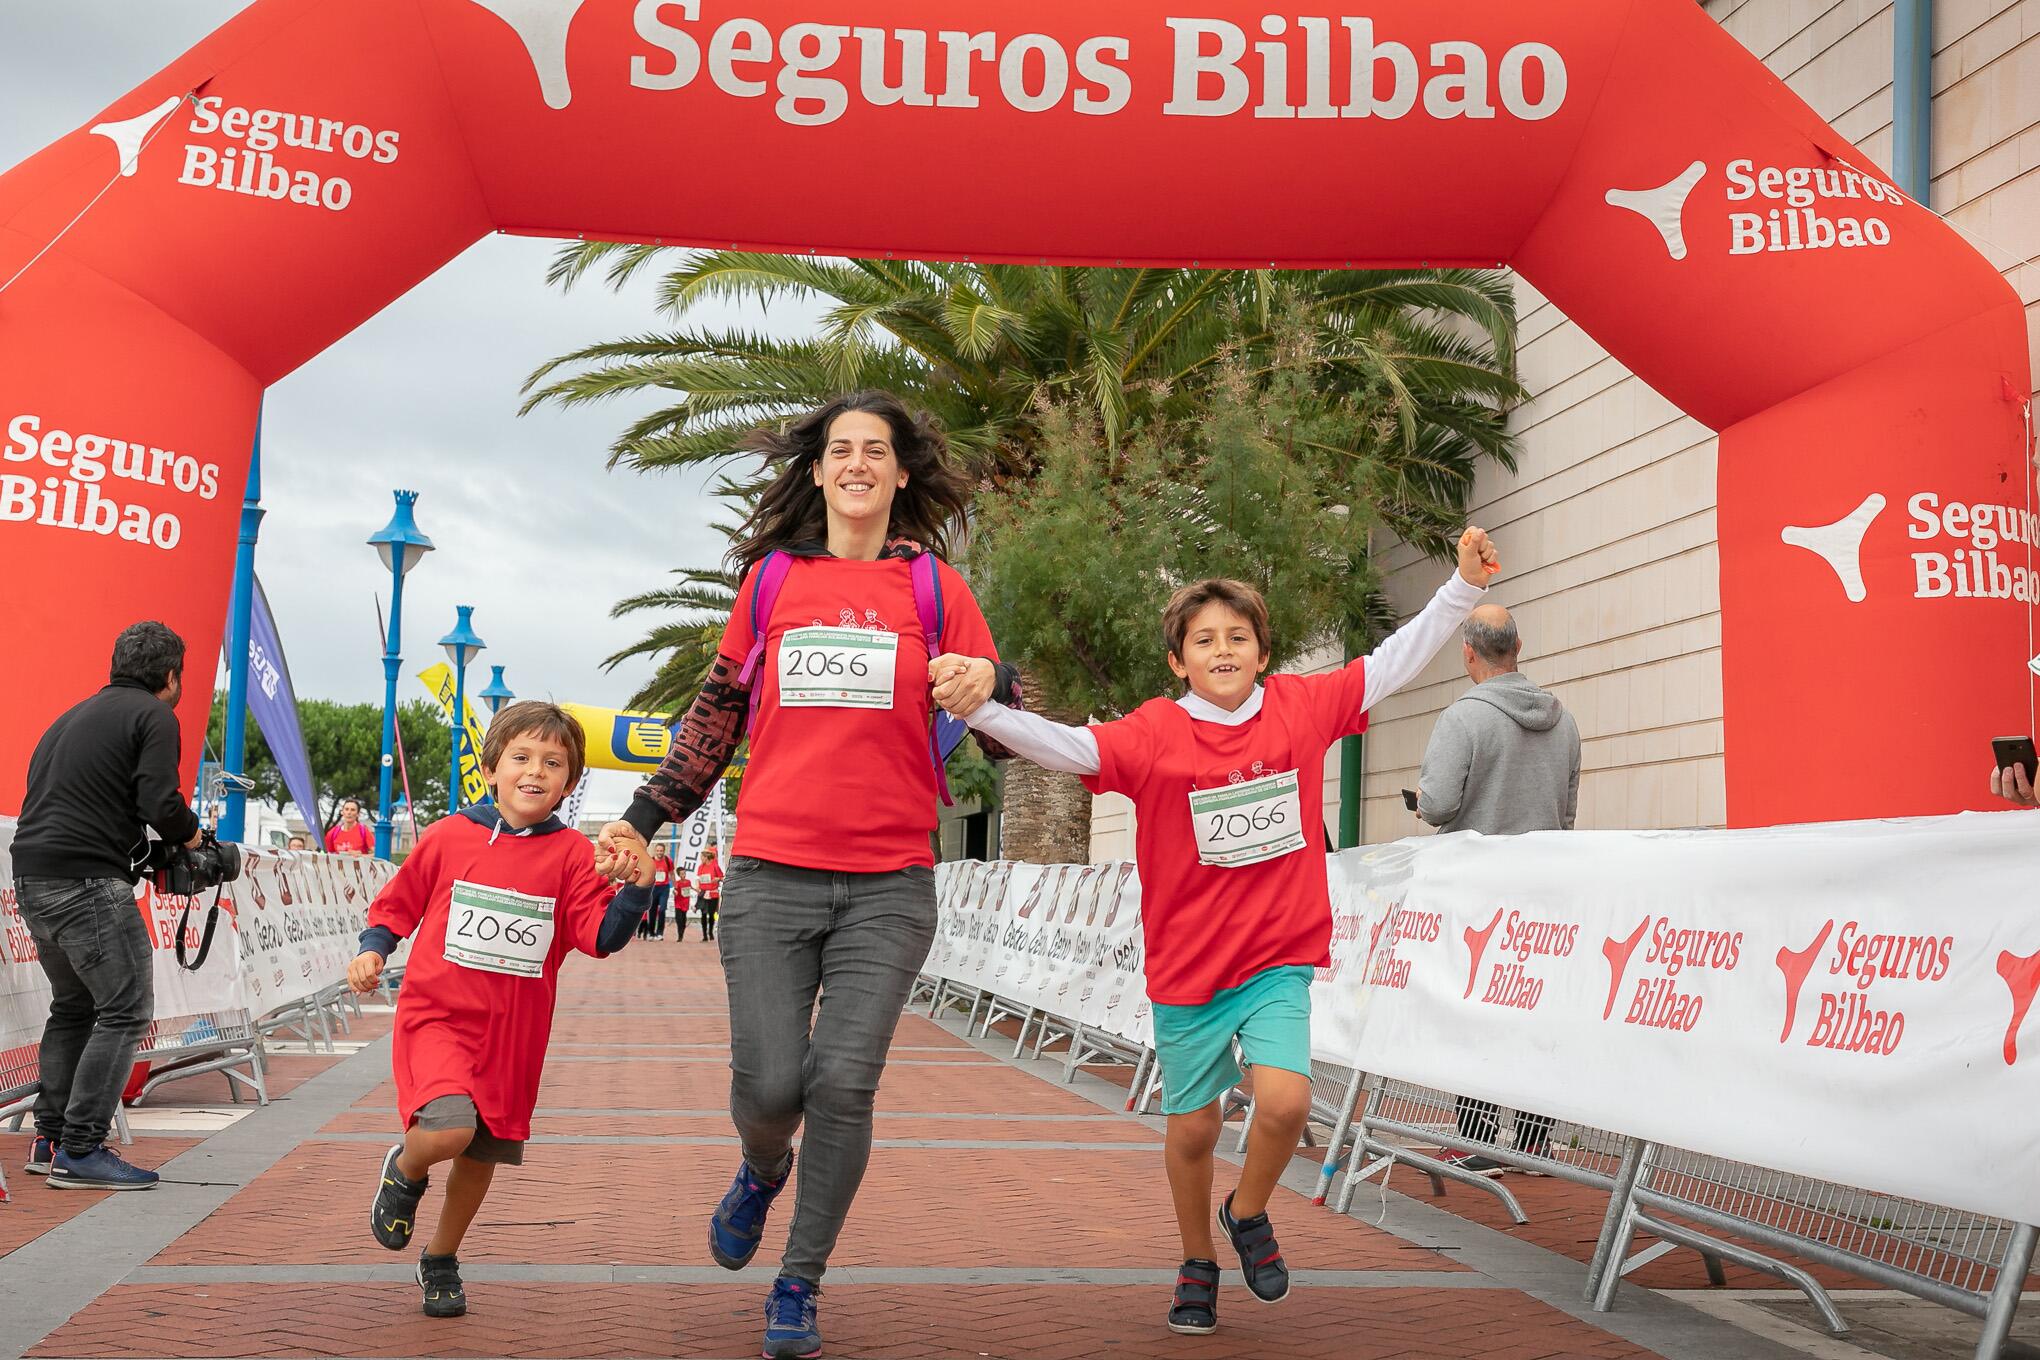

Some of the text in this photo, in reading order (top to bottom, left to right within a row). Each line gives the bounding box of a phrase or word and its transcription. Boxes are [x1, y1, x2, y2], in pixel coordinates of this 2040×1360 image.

[630, 0, 1568, 126] Seguros Bilbao
[189, 96, 400, 164] Seguros
[177, 144, 352, 211] Bilbao
[1725, 159, 1904, 207] Seguros
[1728, 208, 1891, 255] Bilbao
[3, 414, 219, 500] Seguros
[0, 474, 181, 550] Bilbao
[786, 649, 868, 677] 2066
[1208, 800, 1288, 842] 2066
[457, 909, 543, 947] 2066
[1500, 910, 1579, 962] Seguros
[1646, 917, 1743, 976] Seguros
[1829, 920, 1954, 990] Seguros
[1370, 948, 1412, 989] Bilbao
[1481, 962, 1544, 1011] Bilbao
[1624, 977, 1703, 1032] Bilbao
[1806, 991, 1905, 1056] Bilbao
